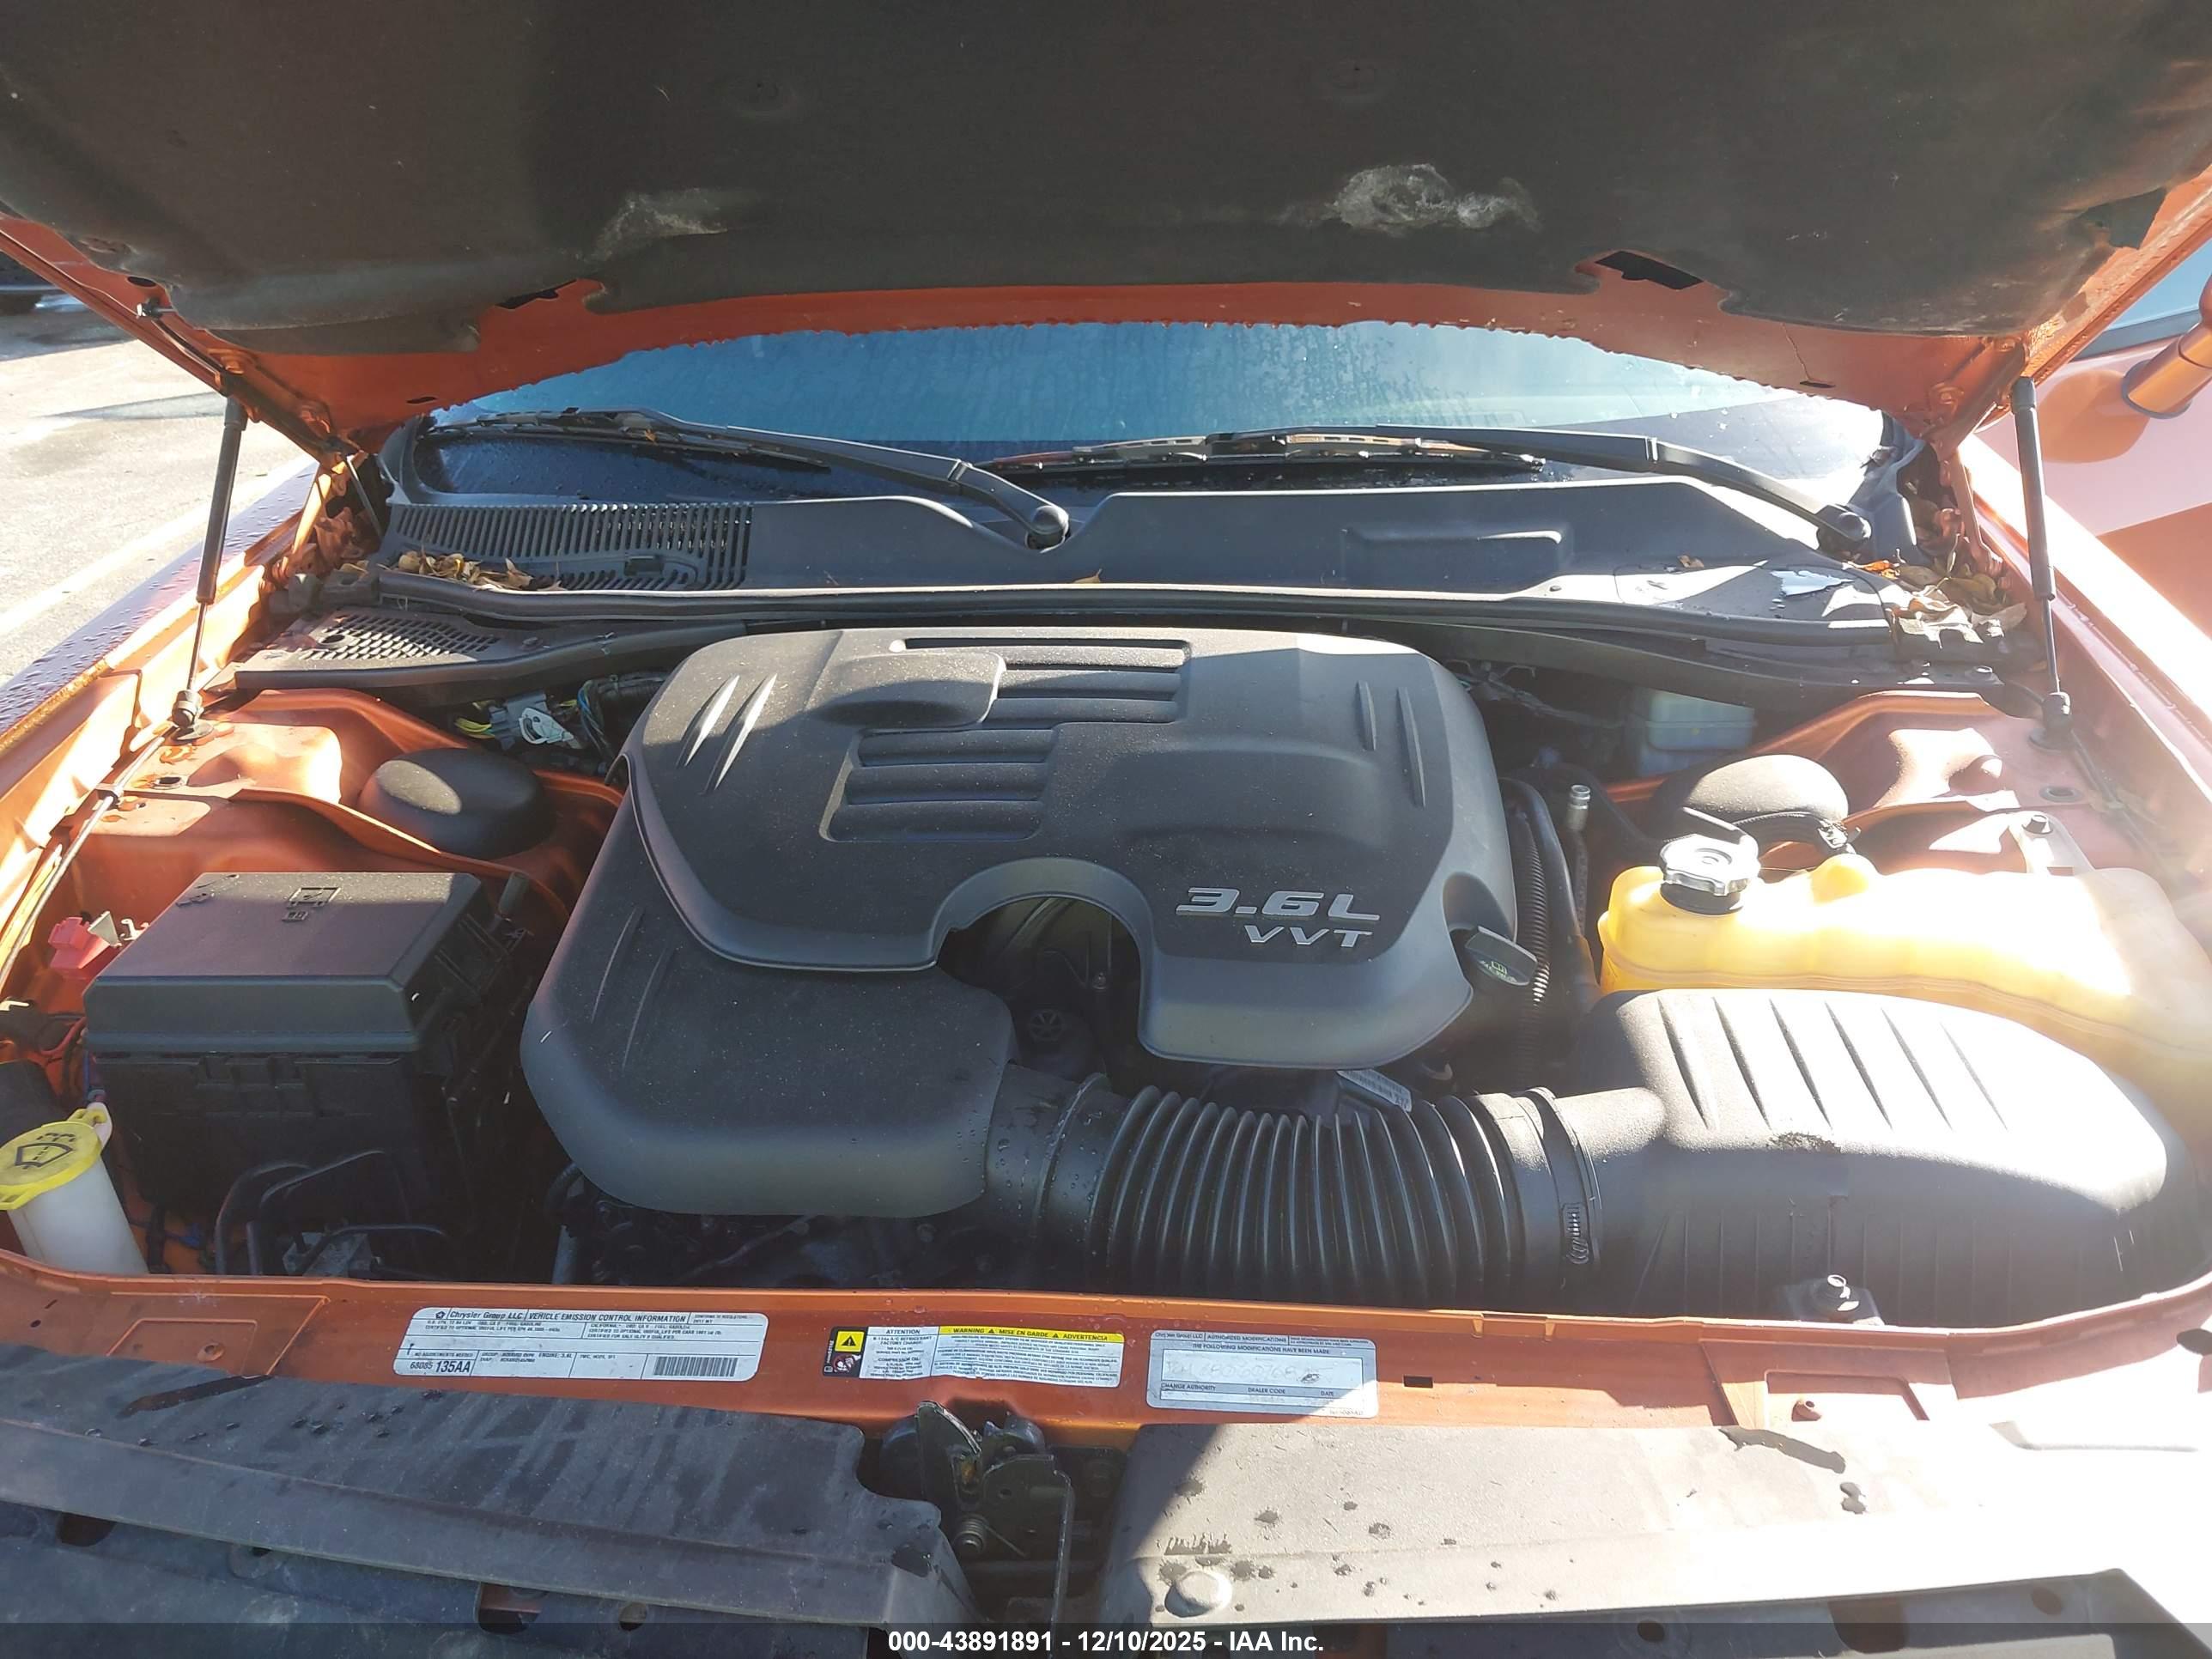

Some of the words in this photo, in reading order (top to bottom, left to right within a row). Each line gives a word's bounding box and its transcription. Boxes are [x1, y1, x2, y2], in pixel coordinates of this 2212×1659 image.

[1176, 886, 1380, 921] 3.6L
[1243, 925, 1373, 948] VVT
[450, 1310, 481, 1320] Chrysler
[483, 1311, 506, 1321] Group
[529, 1312, 559, 1321] VEHICLE
[561, 1313, 596, 1322] EMISSION
[635, 1315, 686, 1323] INFORMATION
[1063, 1333, 1108, 1341] ADVERTENCIA
[435, 1360, 471, 1373] 135AA
